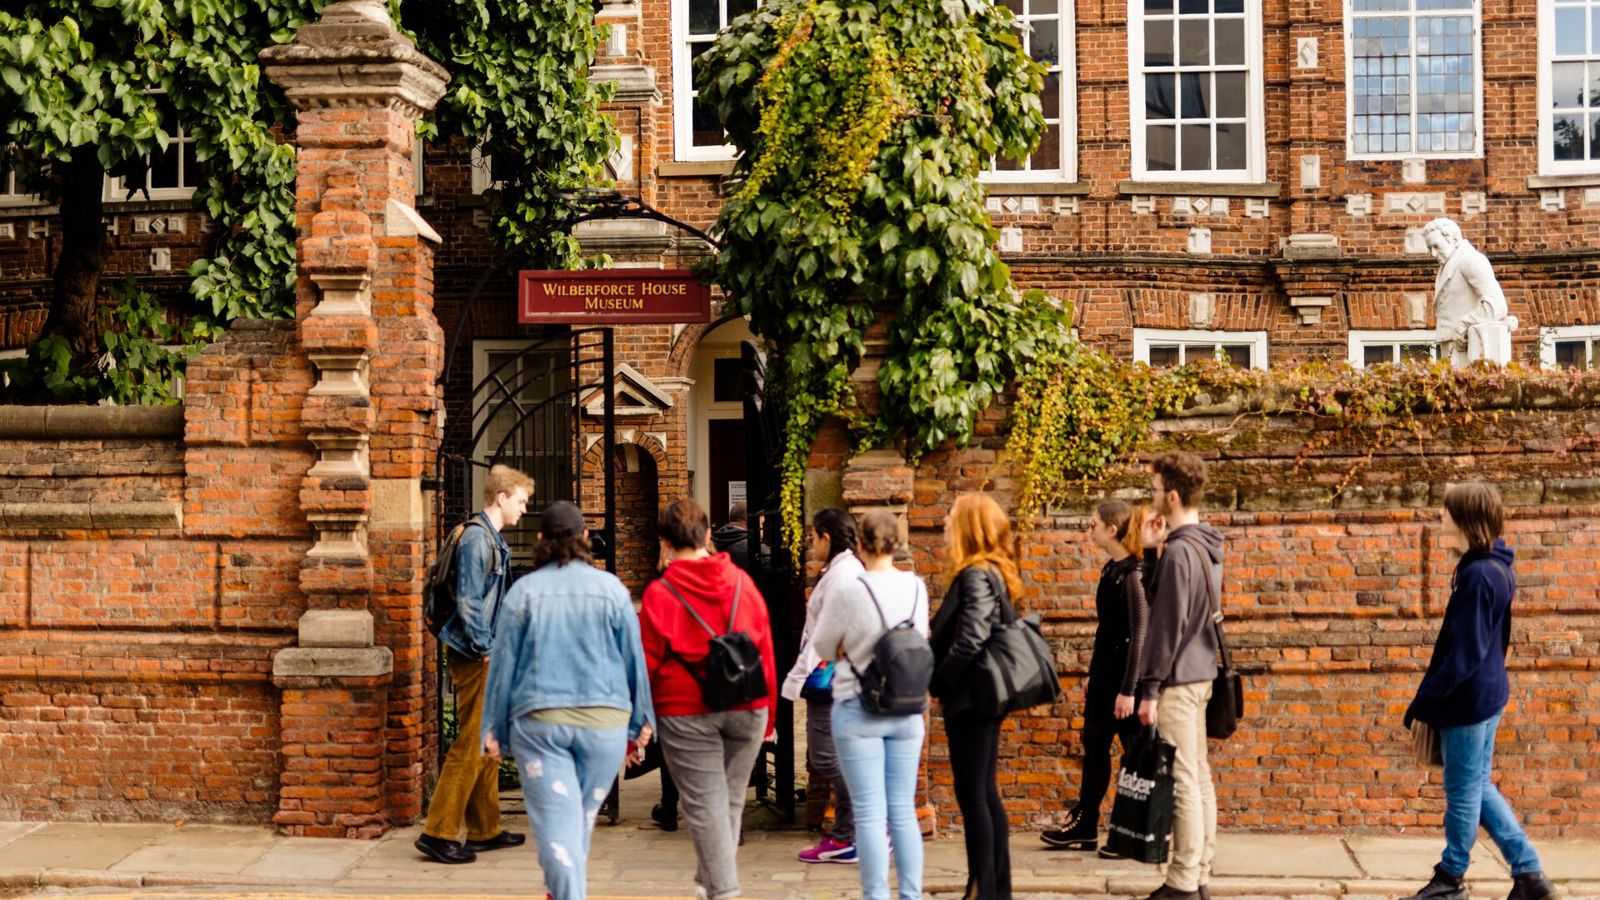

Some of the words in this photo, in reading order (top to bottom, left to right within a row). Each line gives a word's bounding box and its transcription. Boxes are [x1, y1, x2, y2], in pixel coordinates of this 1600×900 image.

[543, 283, 635, 296] WILBERFORCE
[641, 283, 687, 295] HOUSE
[585, 297, 644, 310] MUSEUM
